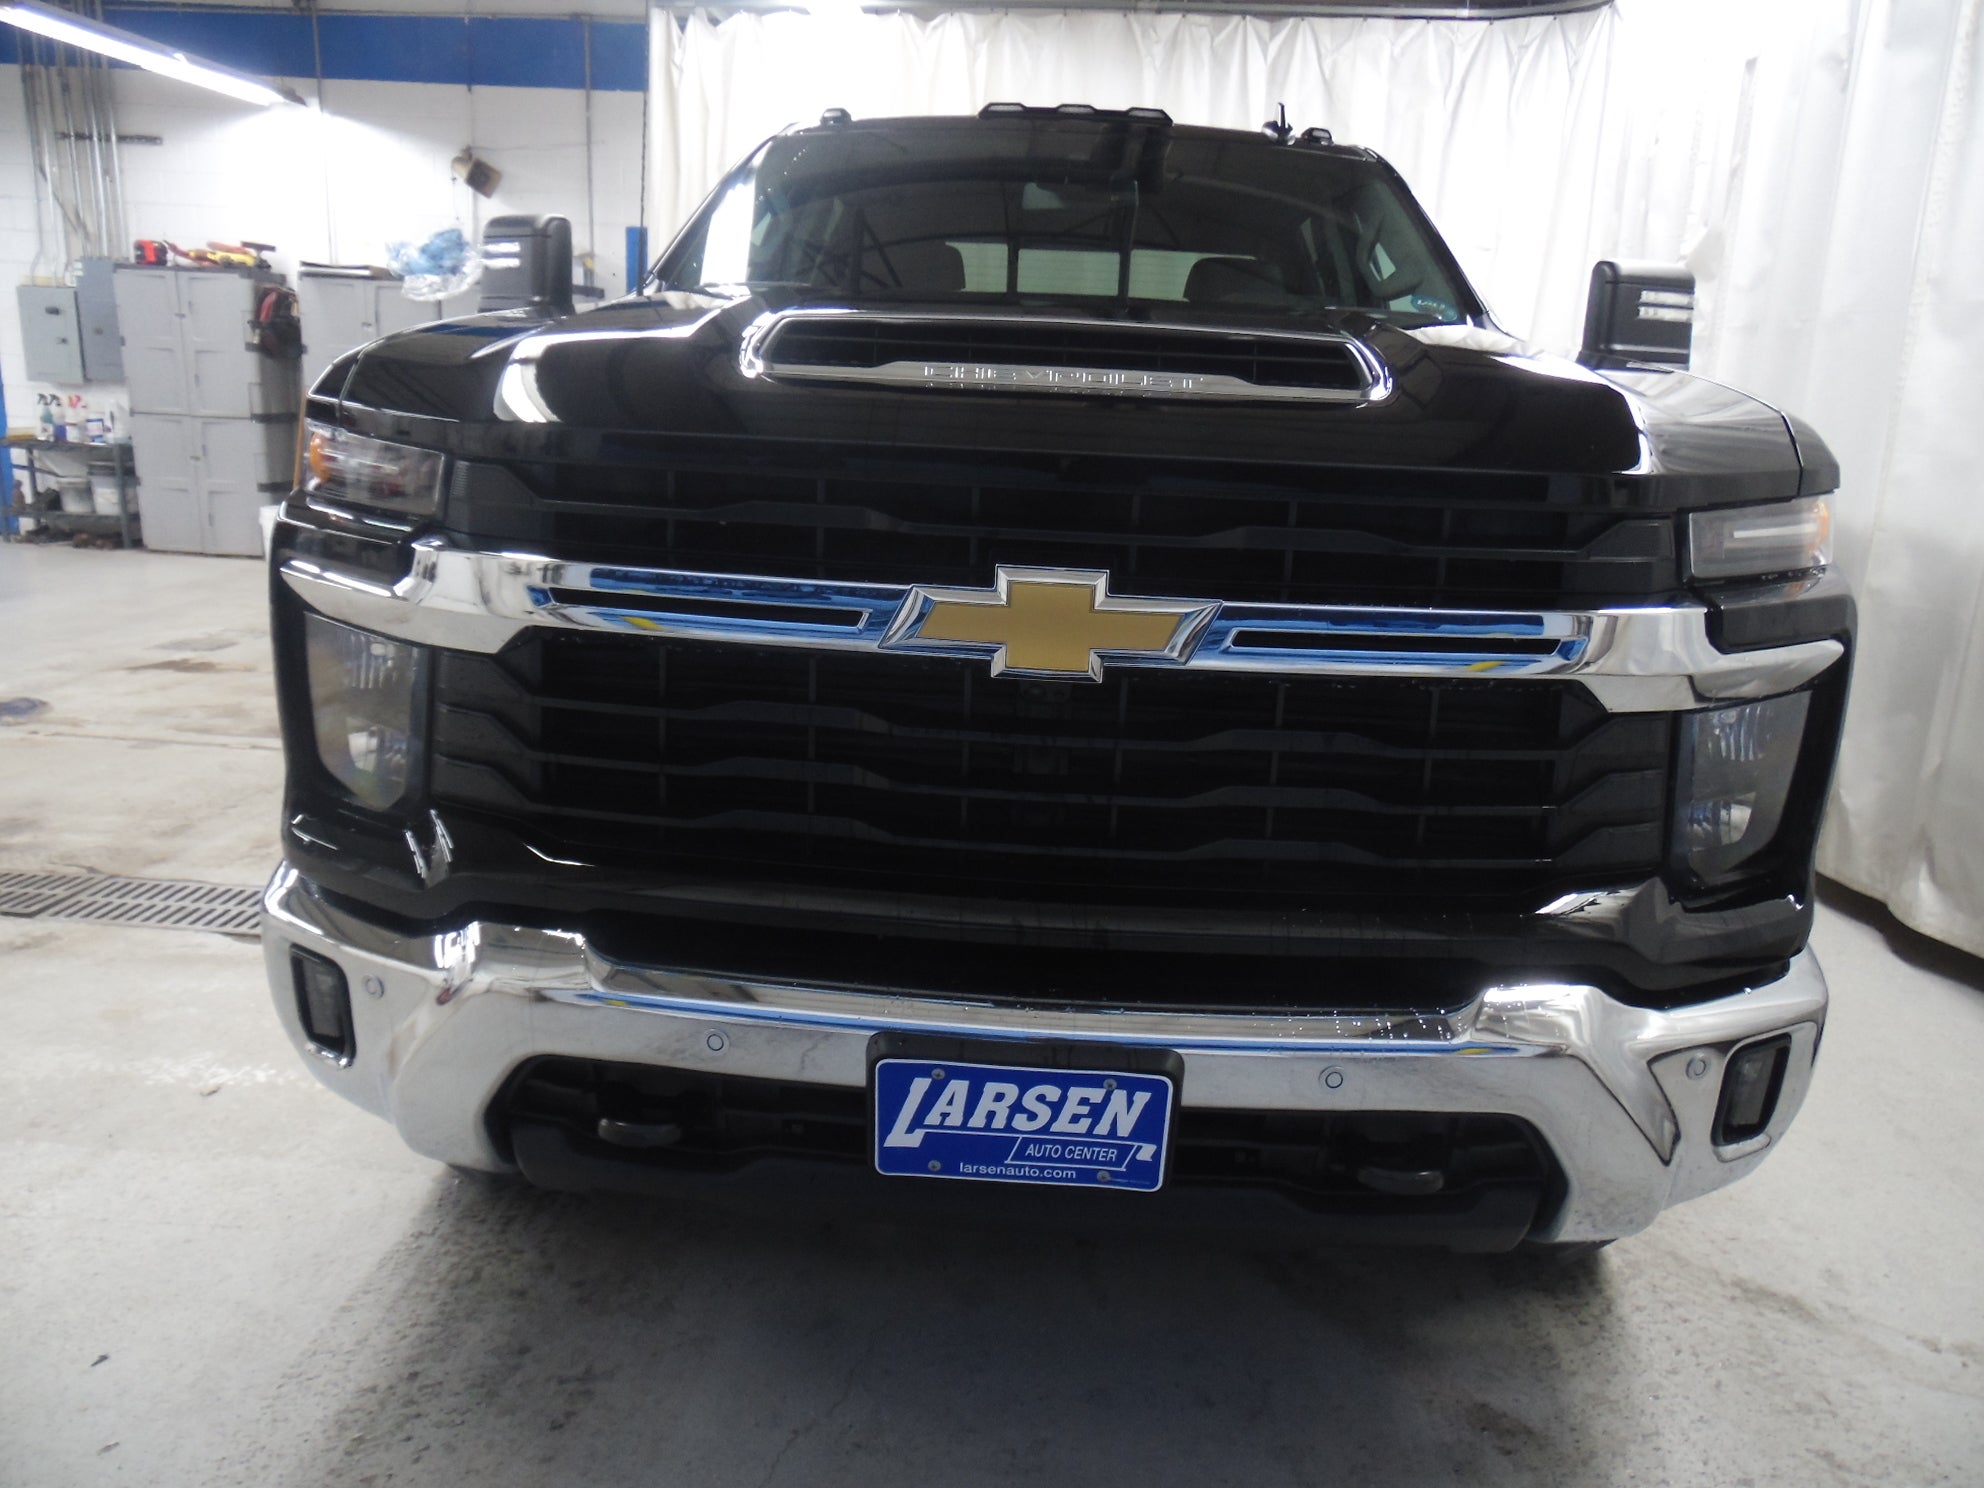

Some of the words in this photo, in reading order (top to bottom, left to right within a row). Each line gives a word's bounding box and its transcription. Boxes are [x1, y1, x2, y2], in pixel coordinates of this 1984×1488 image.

[924, 365, 1205, 388] CHEVROLET
[883, 1077, 1152, 1147] LARSEN
[1025, 1143, 1062, 1158] AUTO
[1065, 1146, 1117, 1162] CENTER
[959, 1162, 1077, 1179] larsenauto.com
